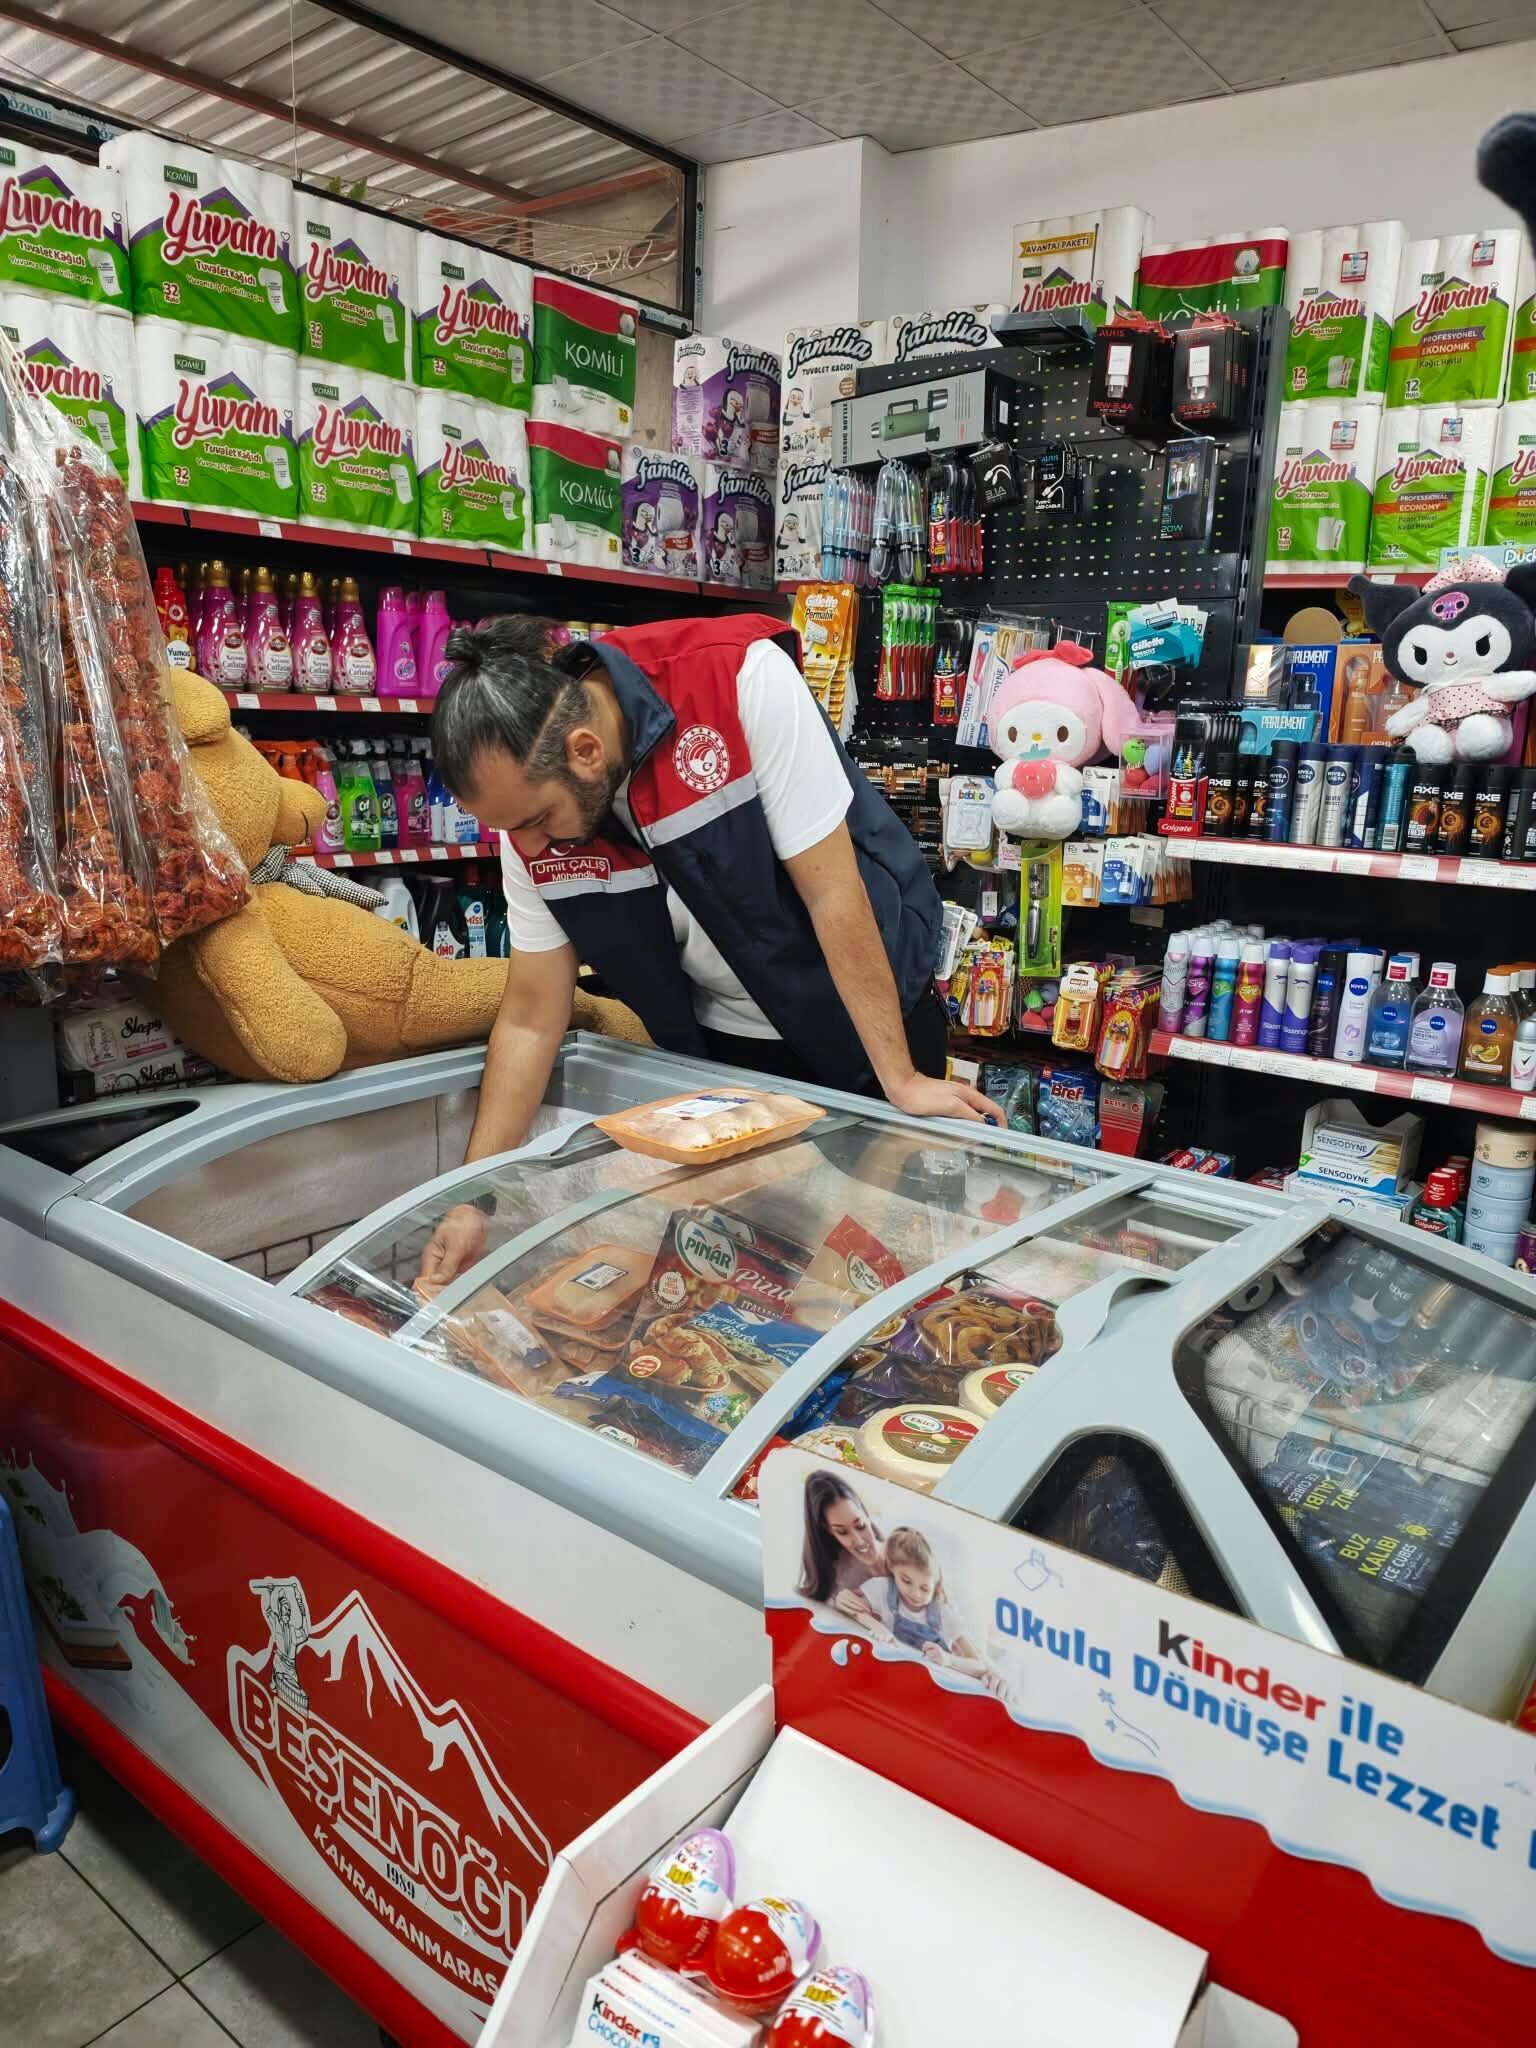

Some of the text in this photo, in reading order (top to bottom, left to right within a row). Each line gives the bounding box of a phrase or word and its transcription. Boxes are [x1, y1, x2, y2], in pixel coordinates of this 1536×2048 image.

[166, 169, 196, 186] KOMİLİ
[163, 191, 277, 262] Yuvam
[1026, 234, 1089, 254] AVANTAJ PAKETİ
[18, 239, 86, 268] Tuvalet Kağıdı
[195, 259, 257, 286] Tuvalet Kağıdı
[306, 241, 388, 300] Yuvam
[162, 282, 180, 298] 32
[436, 283, 521, 342] Yuvam
[1412, 284, 1489, 333] Yuvam
[1291, 298, 1360, 337] Yuvam
[309, 321, 322, 336] 32
[894, 311, 989, 363] familia
[1423, 330, 1478, 343] PROFESYONEL
[565, 340, 625, 378] KOMİLİ
[788, 327, 873, 380] familia
[433, 359, 447, 370] 32
[727, 347, 782, 384] familia
[802, 365, 831, 377] TUVALET
[1292, 367, 1307, 379] 12
[12, 352, 101, 402] uvam
[1405, 379, 1419, 392] 12
[174, 378, 280, 446] Yuvam
[314, 404, 401, 466] Yuvam
[782, 435, 791, 452] 3
[203, 443, 236, 459] Tuvalet
[720, 439, 729, 456] 3
[174, 466, 190, 480] 32
[340, 462, 370, 477] Tuvalet
[439, 441, 510, 492] Yuvam
[637, 456, 699, 492] familia
[1389, 456, 1459, 492] Yuvam
[718, 469, 772, 506] familia
[1275, 459, 1349, 499] Yuvam
[311, 483, 326, 496] 32
[559, 479, 614, 510] KOMİLİ
[1400, 493, 1449, 502] PROFESSIONAL
[1399, 502, 1440, 512] ECONOMY
[1277, 527, 1290, 540] 12
[631, 547, 641, 564] 3
[1387, 544, 1399, 553] 12
[713, 560, 722, 577] 3
[805, 595, 839, 609] Gillette
[804, 609, 834, 621] Permatik
[1131, 636, 1165, 652] Gillette
[1261, 715, 1307, 730] PARLEMENT
[1208, 778, 1232, 787] AXE
[1327, 770, 1346, 778] NIVEA
[1254, 780, 1269, 788] AX
[1413, 785, 1441, 795] AXE
[359, 799, 370, 812] Cif
[382, 799, 391, 810] Cif
[414, 796, 424, 808] Cif
[1169, 782, 1177, 814] Colgate
[1476, 793, 1501, 802] AXE
[1161, 823, 1193, 833] Colgate
[535, 858, 607, 875] Ümit ÇALIŞ
[552, 871, 597, 883] Mühendis
[436, 944, 454, 957] OMO
[1317, 979, 1334, 987] NIVEA
[1350, 983, 1368, 991] NIVEA
[1383, 1010, 1397, 1018] NIVEA
[121, 1015, 163, 1040] Sleepy
[1429, 1020, 1445, 1028] NIVEA
[1481, 1023, 1497, 1031] NIVEA
[1051, 1082, 1084, 1102] Bref
[1316, 1134, 1368, 1153] SENSODYNE
[1318, 1166, 1369, 1185] SENSODYNE
[684, 1236, 732, 1270] PINAR
[734, 1267, 794, 1301] Pizza
[1303, 1478, 1340, 1511] KALIBI
[1339, 1533, 1371, 1560] BUZ
[1359, 1535, 1401, 1576] KALIBI
[1381, 1543, 1418, 1583] ICE CUBES
[1157, 1618, 1406, 1758] Kinder ile
[994, 1597, 1500, 1851] Okula Dönüşe Lezzet
[241, 1670, 545, 1954] BEŞENOĞ
[385, 1860, 416, 1900] 1989
[591, 1992, 642, 2041] Kinder
